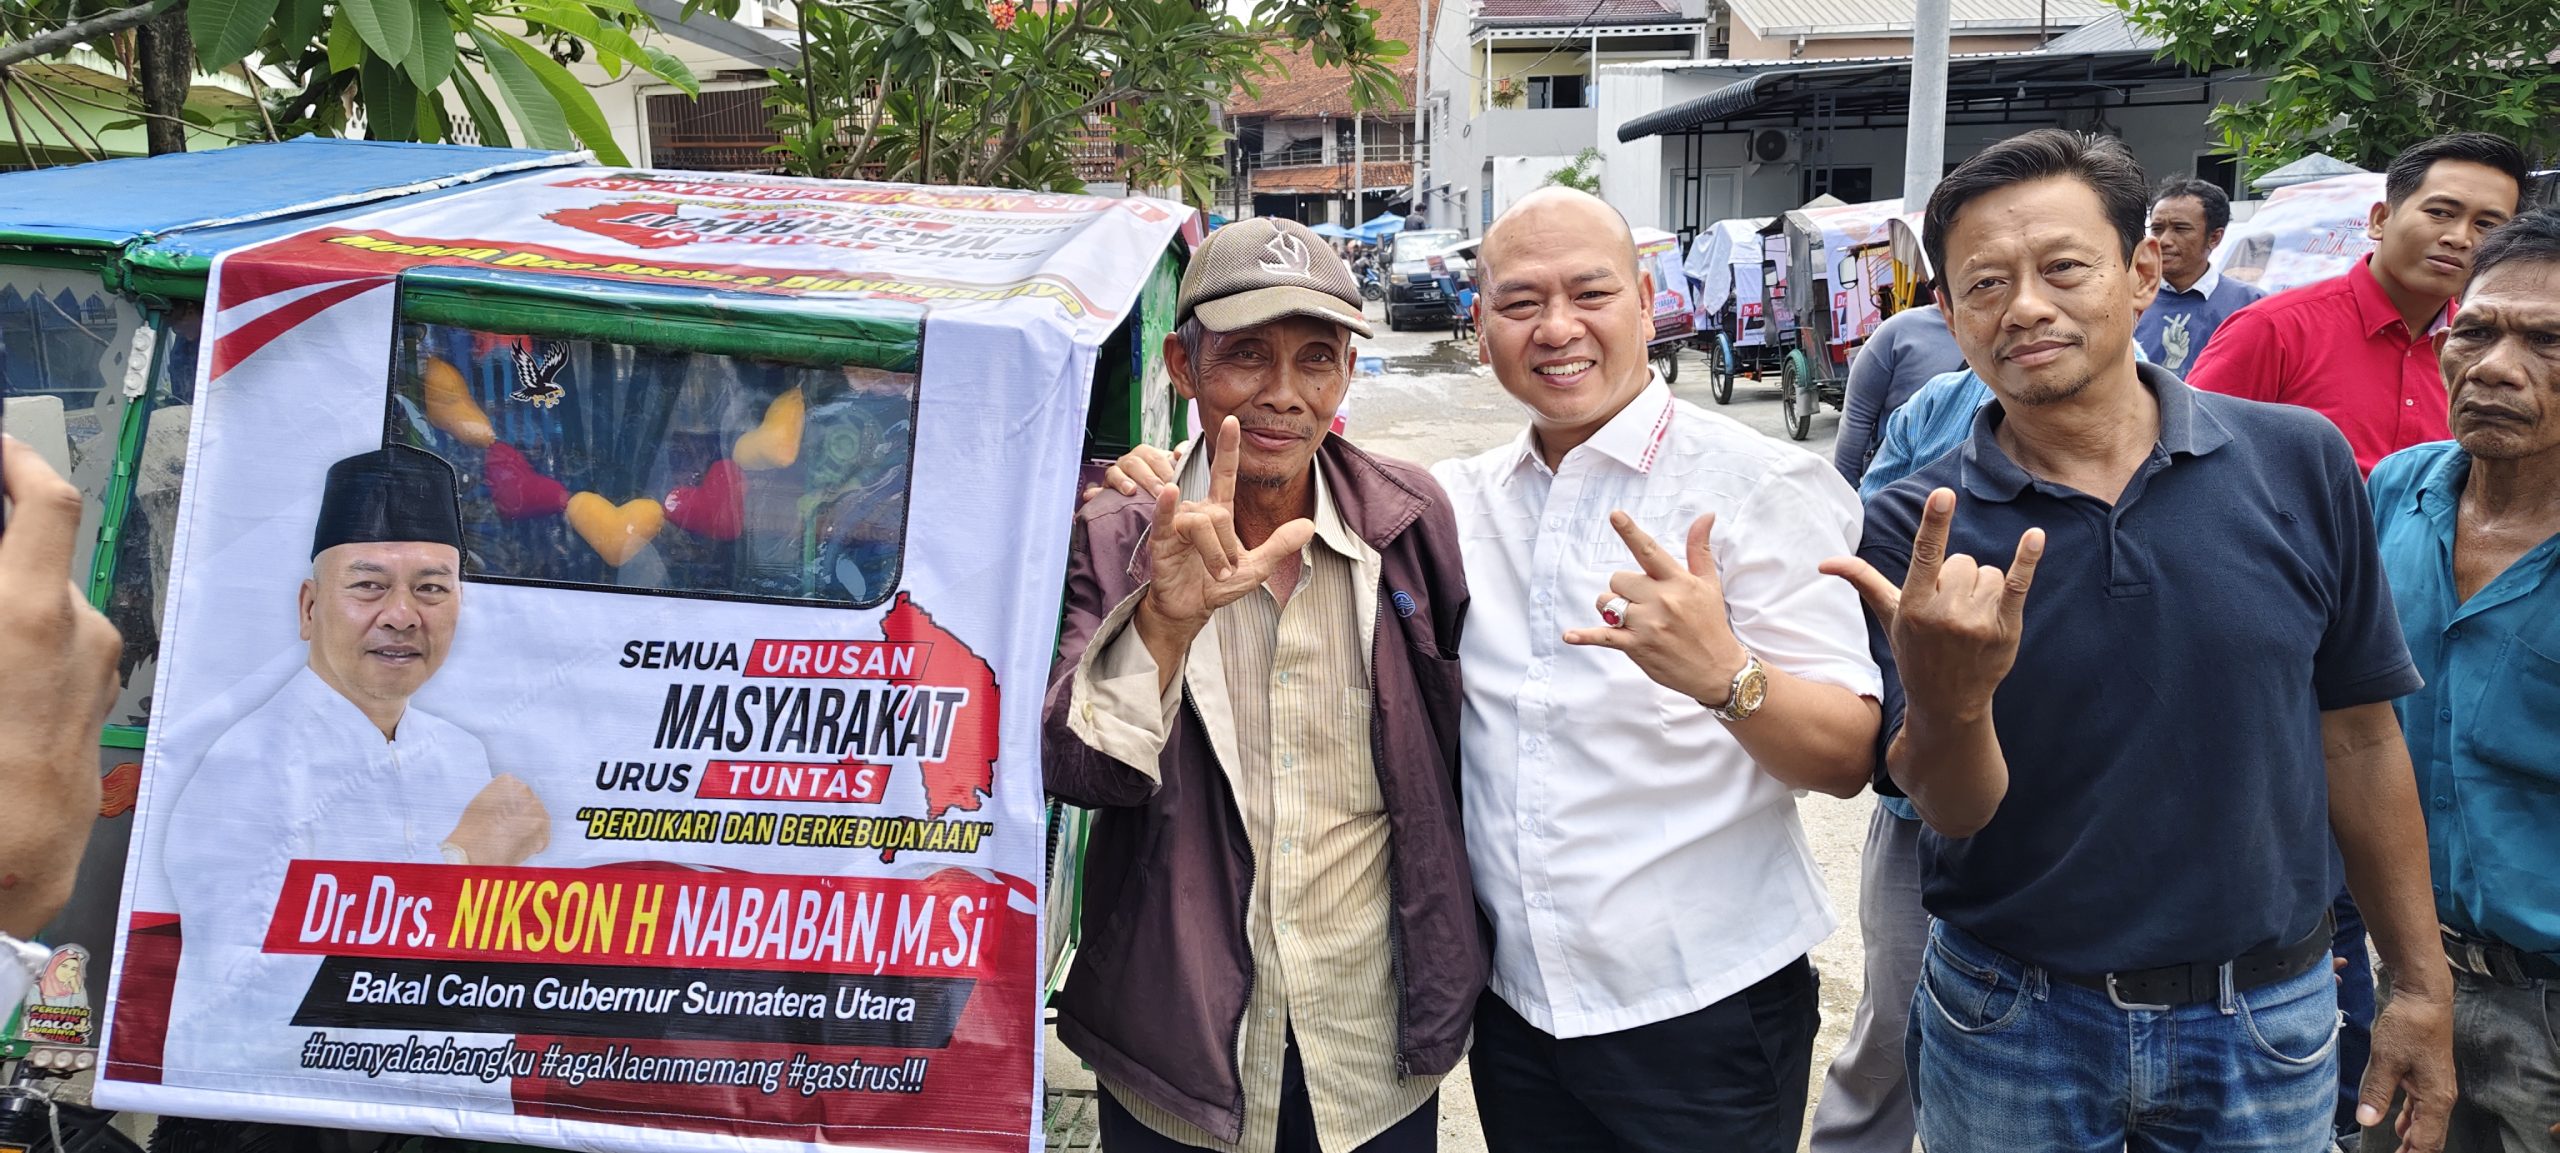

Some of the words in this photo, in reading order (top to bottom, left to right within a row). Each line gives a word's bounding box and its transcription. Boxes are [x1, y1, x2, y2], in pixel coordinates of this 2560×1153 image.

[881, 191, 1021, 210] NIKSON
[598, 213, 1006, 250] MASYARAKAT
[957, 225, 1071, 235] URUS
[326, 235, 506, 261] Mohon
[495, 252, 596, 271] Doa
[895, 246, 1047, 260] SEMUA
[619, 640, 738, 671] SEMUA
[761, 643, 915, 675] URUSAN
[653, 683, 966, 758] MASYARAKAT
[596, 761, 691, 792] URUS
[728, 764, 875, 799] TUNTAS
[722, 812, 772, 846] DAN
[299, 873, 436, 948] Dr.Drs.
[447, 877, 622, 955] NIKSON
[624, 883, 664, 955] H
[667, 885, 986, 975] NABABAN,M.Si
[31, 1005, 89, 1017] PERCUMA
[346, 971, 431, 1005] Bakal
[436, 973, 526, 1009] Calon
[532, 978, 678, 1013] Gubernur
[682, 982, 826, 1020] Sumatera
[834, 986, 916, 1022] Utara
[30, 1019, 75, 1030] KALO
[302, 1033, 535, 1084] #menyalaabangku
[540, 1045, 783, 1094] #agaklaenmemang
[787, 1053, 927, 1097] #gastrus!!!
